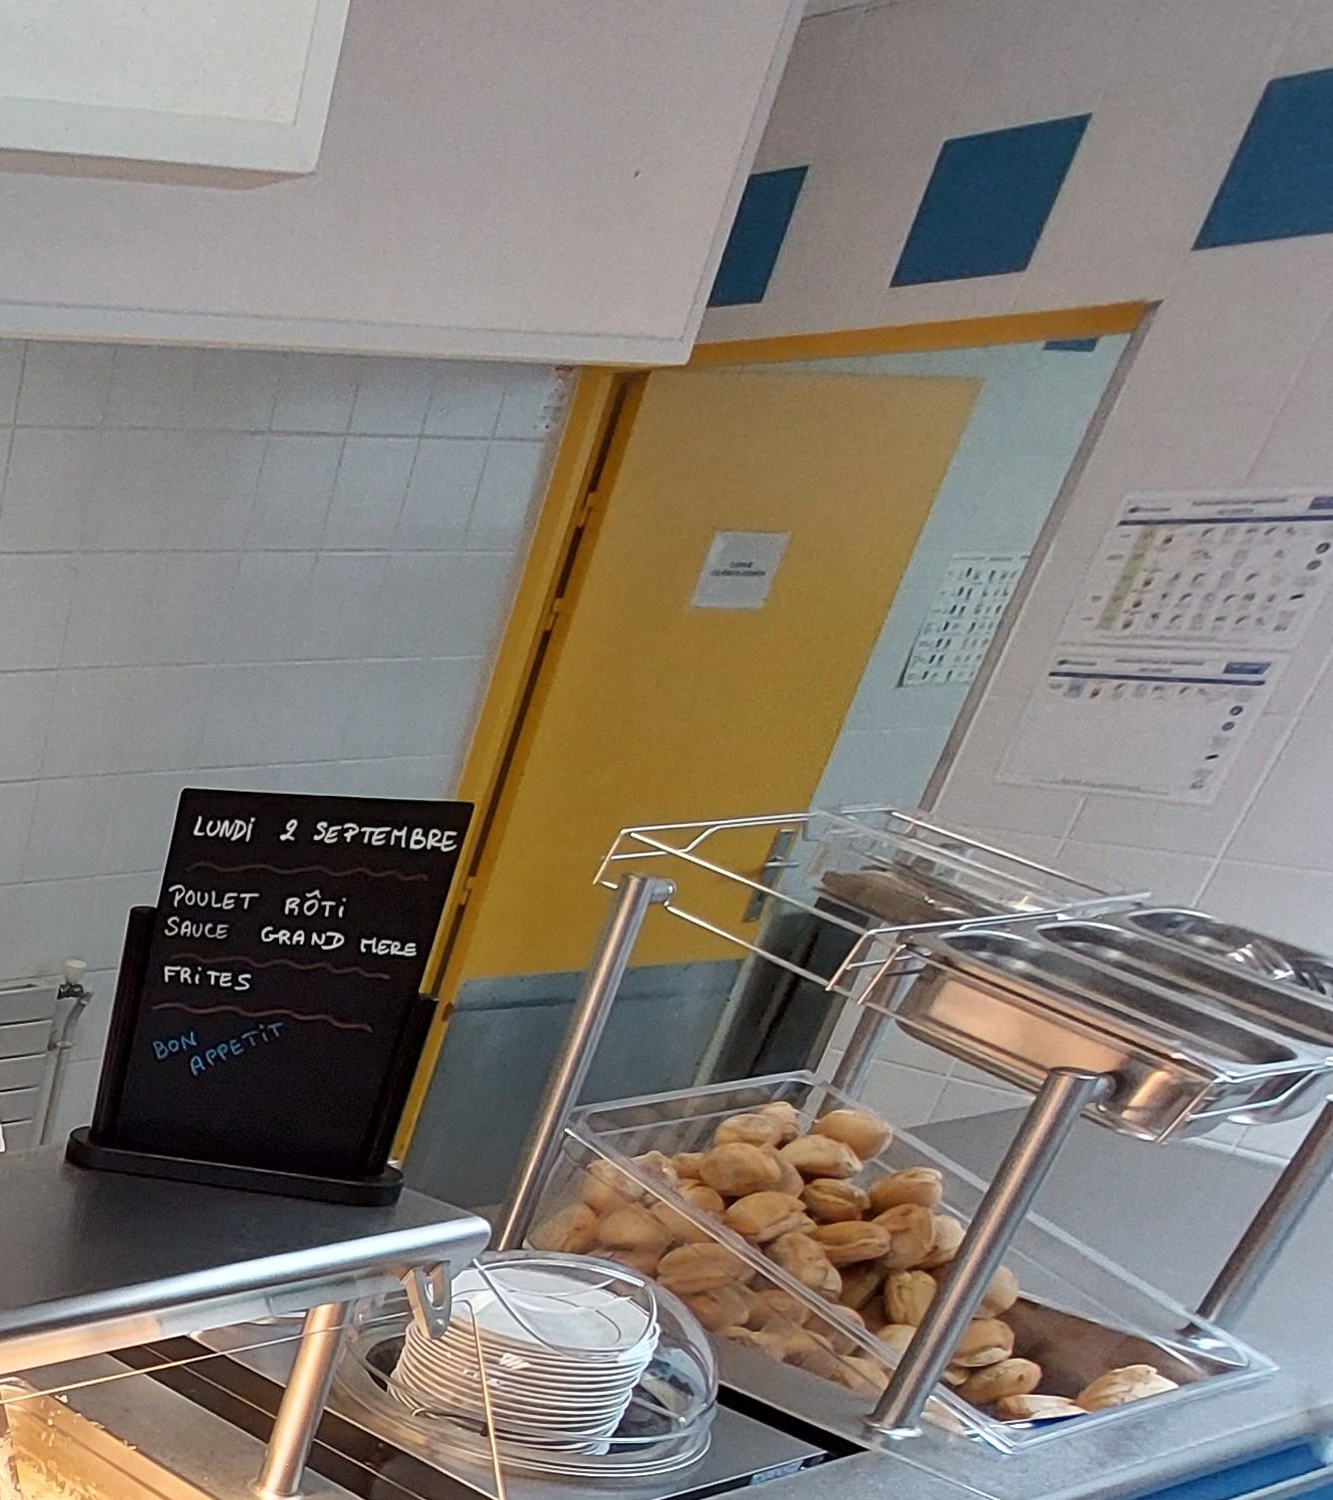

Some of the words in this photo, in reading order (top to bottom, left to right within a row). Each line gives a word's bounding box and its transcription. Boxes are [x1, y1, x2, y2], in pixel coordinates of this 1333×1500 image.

[279, 819, 296, 842] 2
[313, 821, 459, 852] SEPTEMBRE
[168, 884, 260, 911] POULET
[163, 917, 229, 940] SAUCE
[261, 926, 345, 950] GRAND
[359, 938, 418, 958] MERE
[151, 1031, 198, 1060] BON
